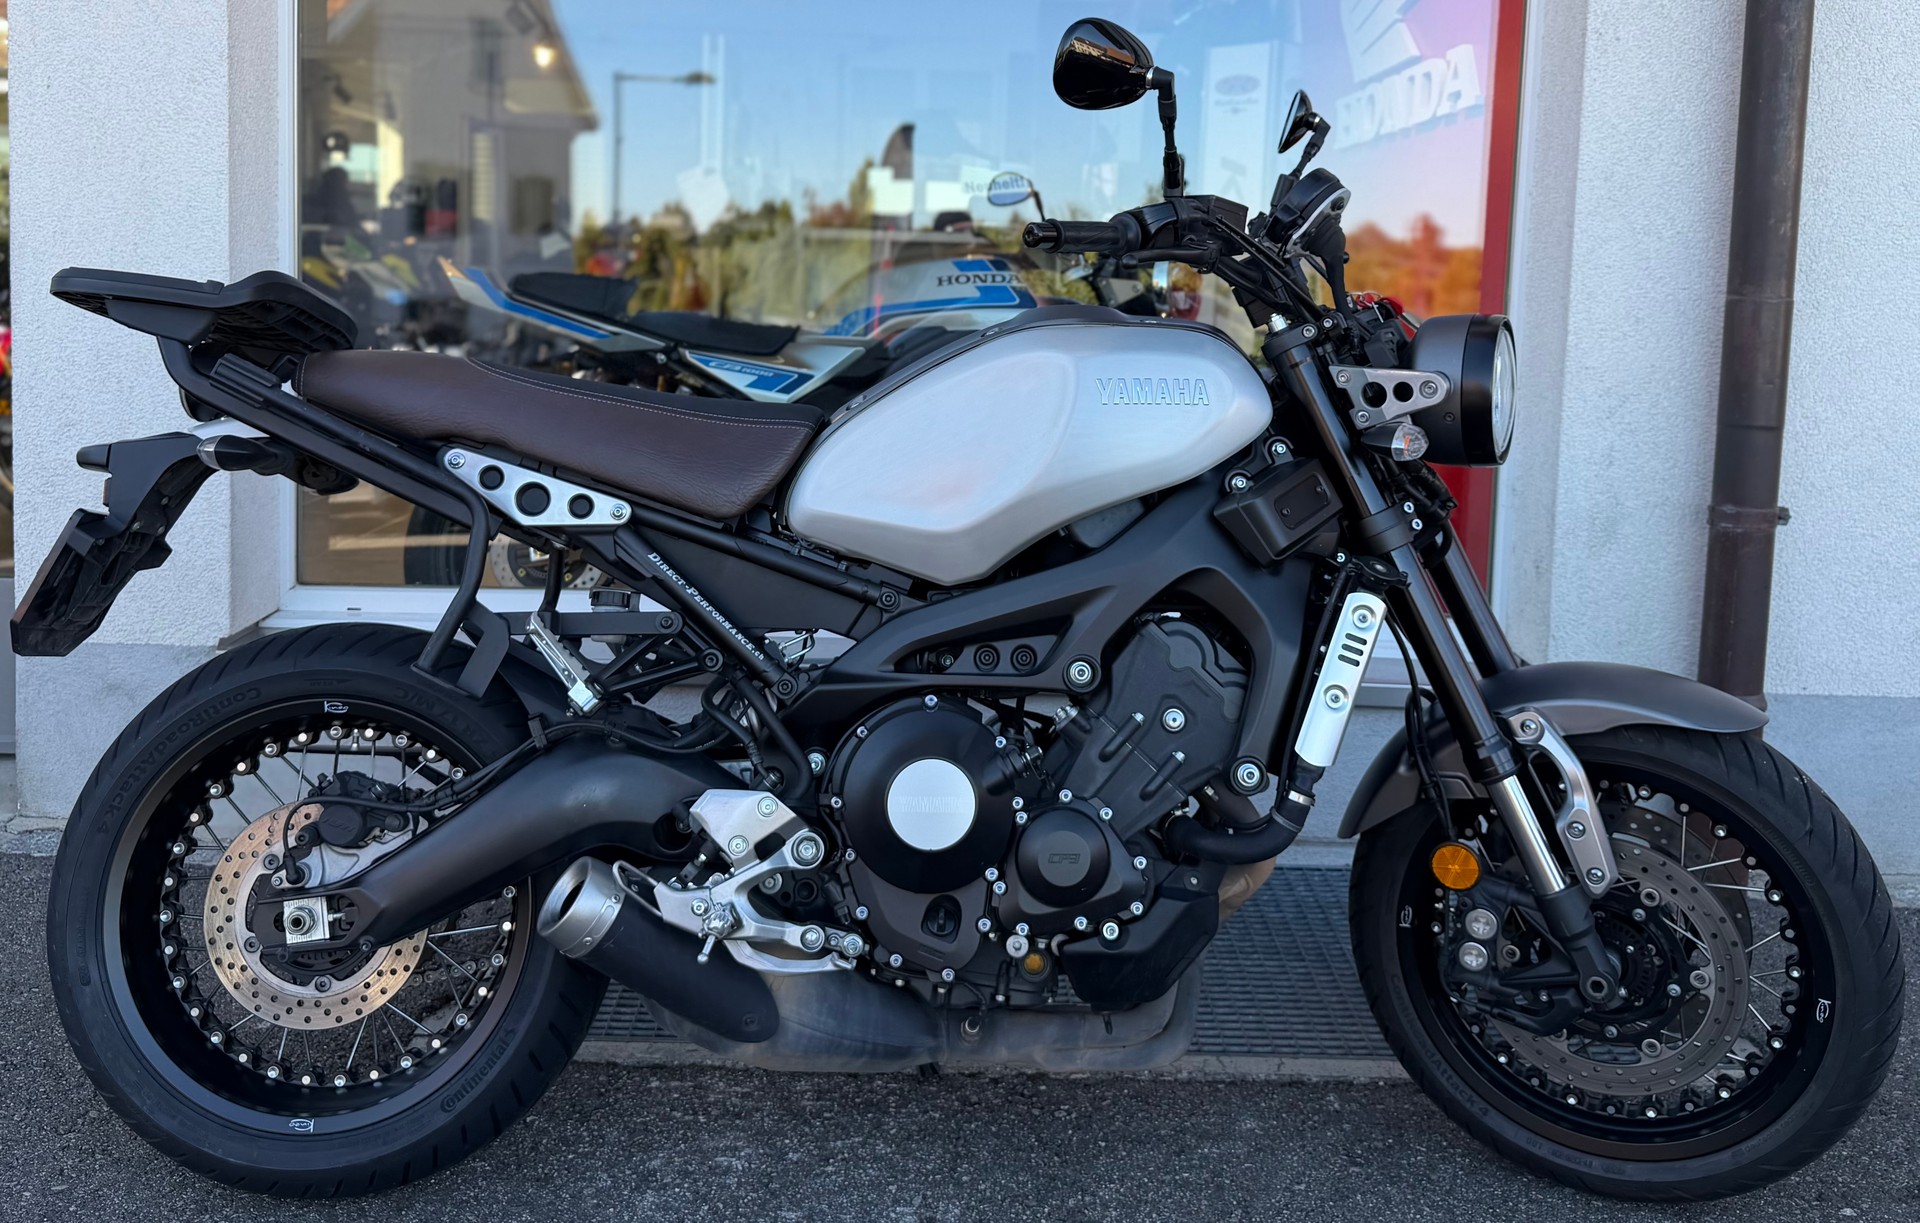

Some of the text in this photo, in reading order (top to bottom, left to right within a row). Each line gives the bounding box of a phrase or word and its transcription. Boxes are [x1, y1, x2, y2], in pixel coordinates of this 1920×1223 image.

[1334, 43, 1483, 150] HONDA
[936, 274, 1023, 287] HONDA
[1095, 378, 1209, 406] YAMAHA
[106, 687, 261, 820] ContiRoadAttack
[440, 1038, 510, 1113] Continental
